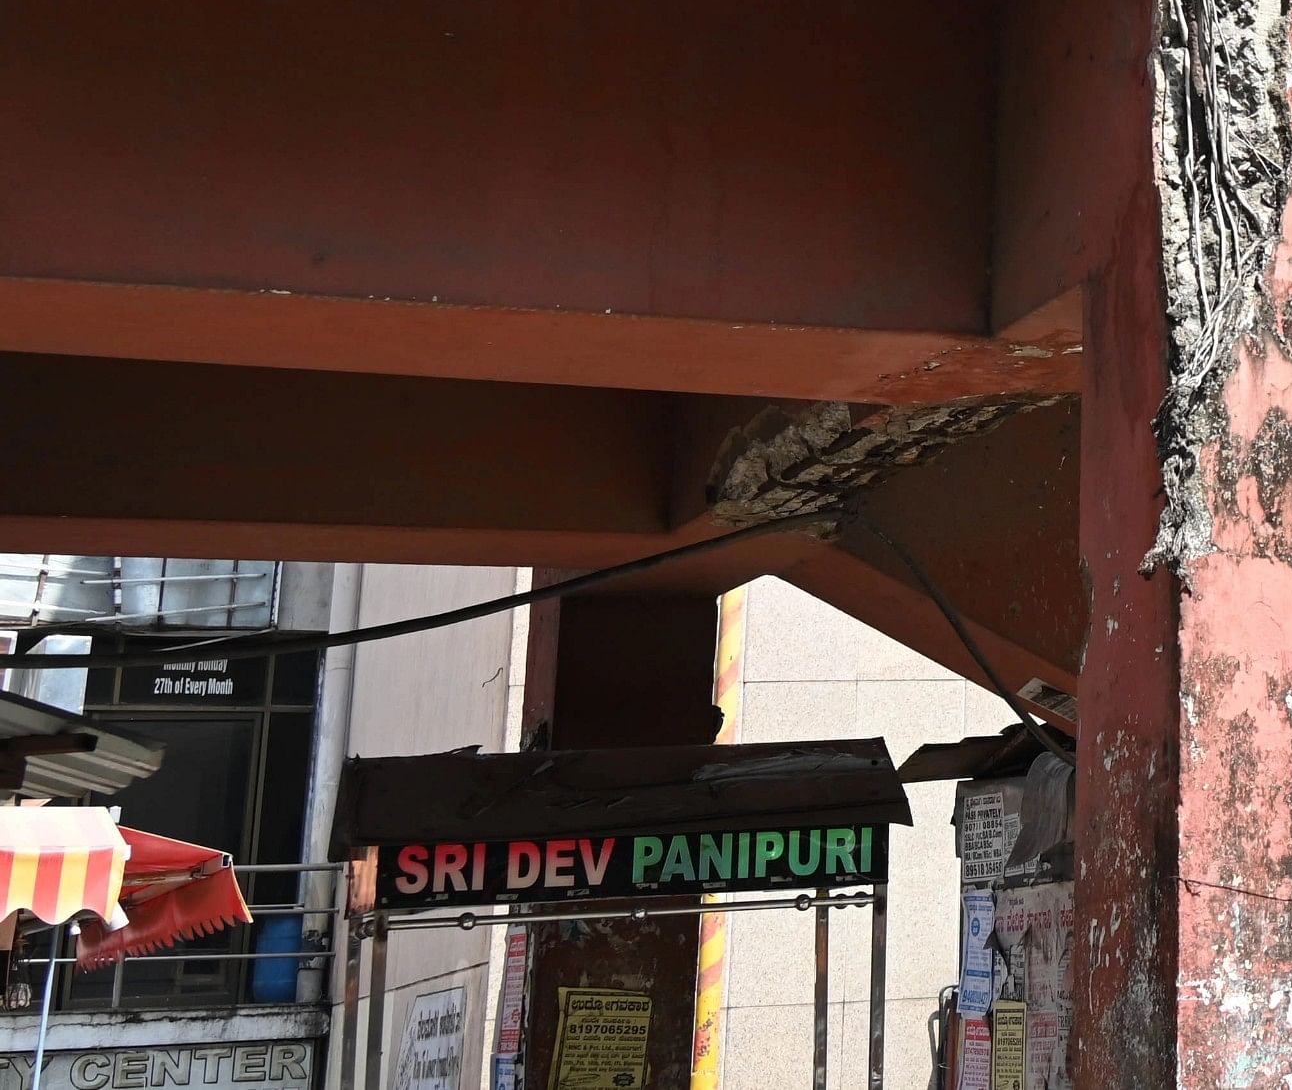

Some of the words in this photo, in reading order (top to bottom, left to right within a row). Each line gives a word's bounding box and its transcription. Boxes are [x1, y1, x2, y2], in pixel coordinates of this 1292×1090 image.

[154, 677, 172, 694] 27th
[174, 677, 183, 694] of
[184, 677, 206, 696] Every
[207, 677, 234, 695] Month
[395, 841, 485, 895] SRI
[506, 837, 617, 890] DEV
[632, 826, 874, 885] PANIPURI
[569, 1024, 647, 1035] 8197065295
[70, 1043, 308, 1090] CENTER
